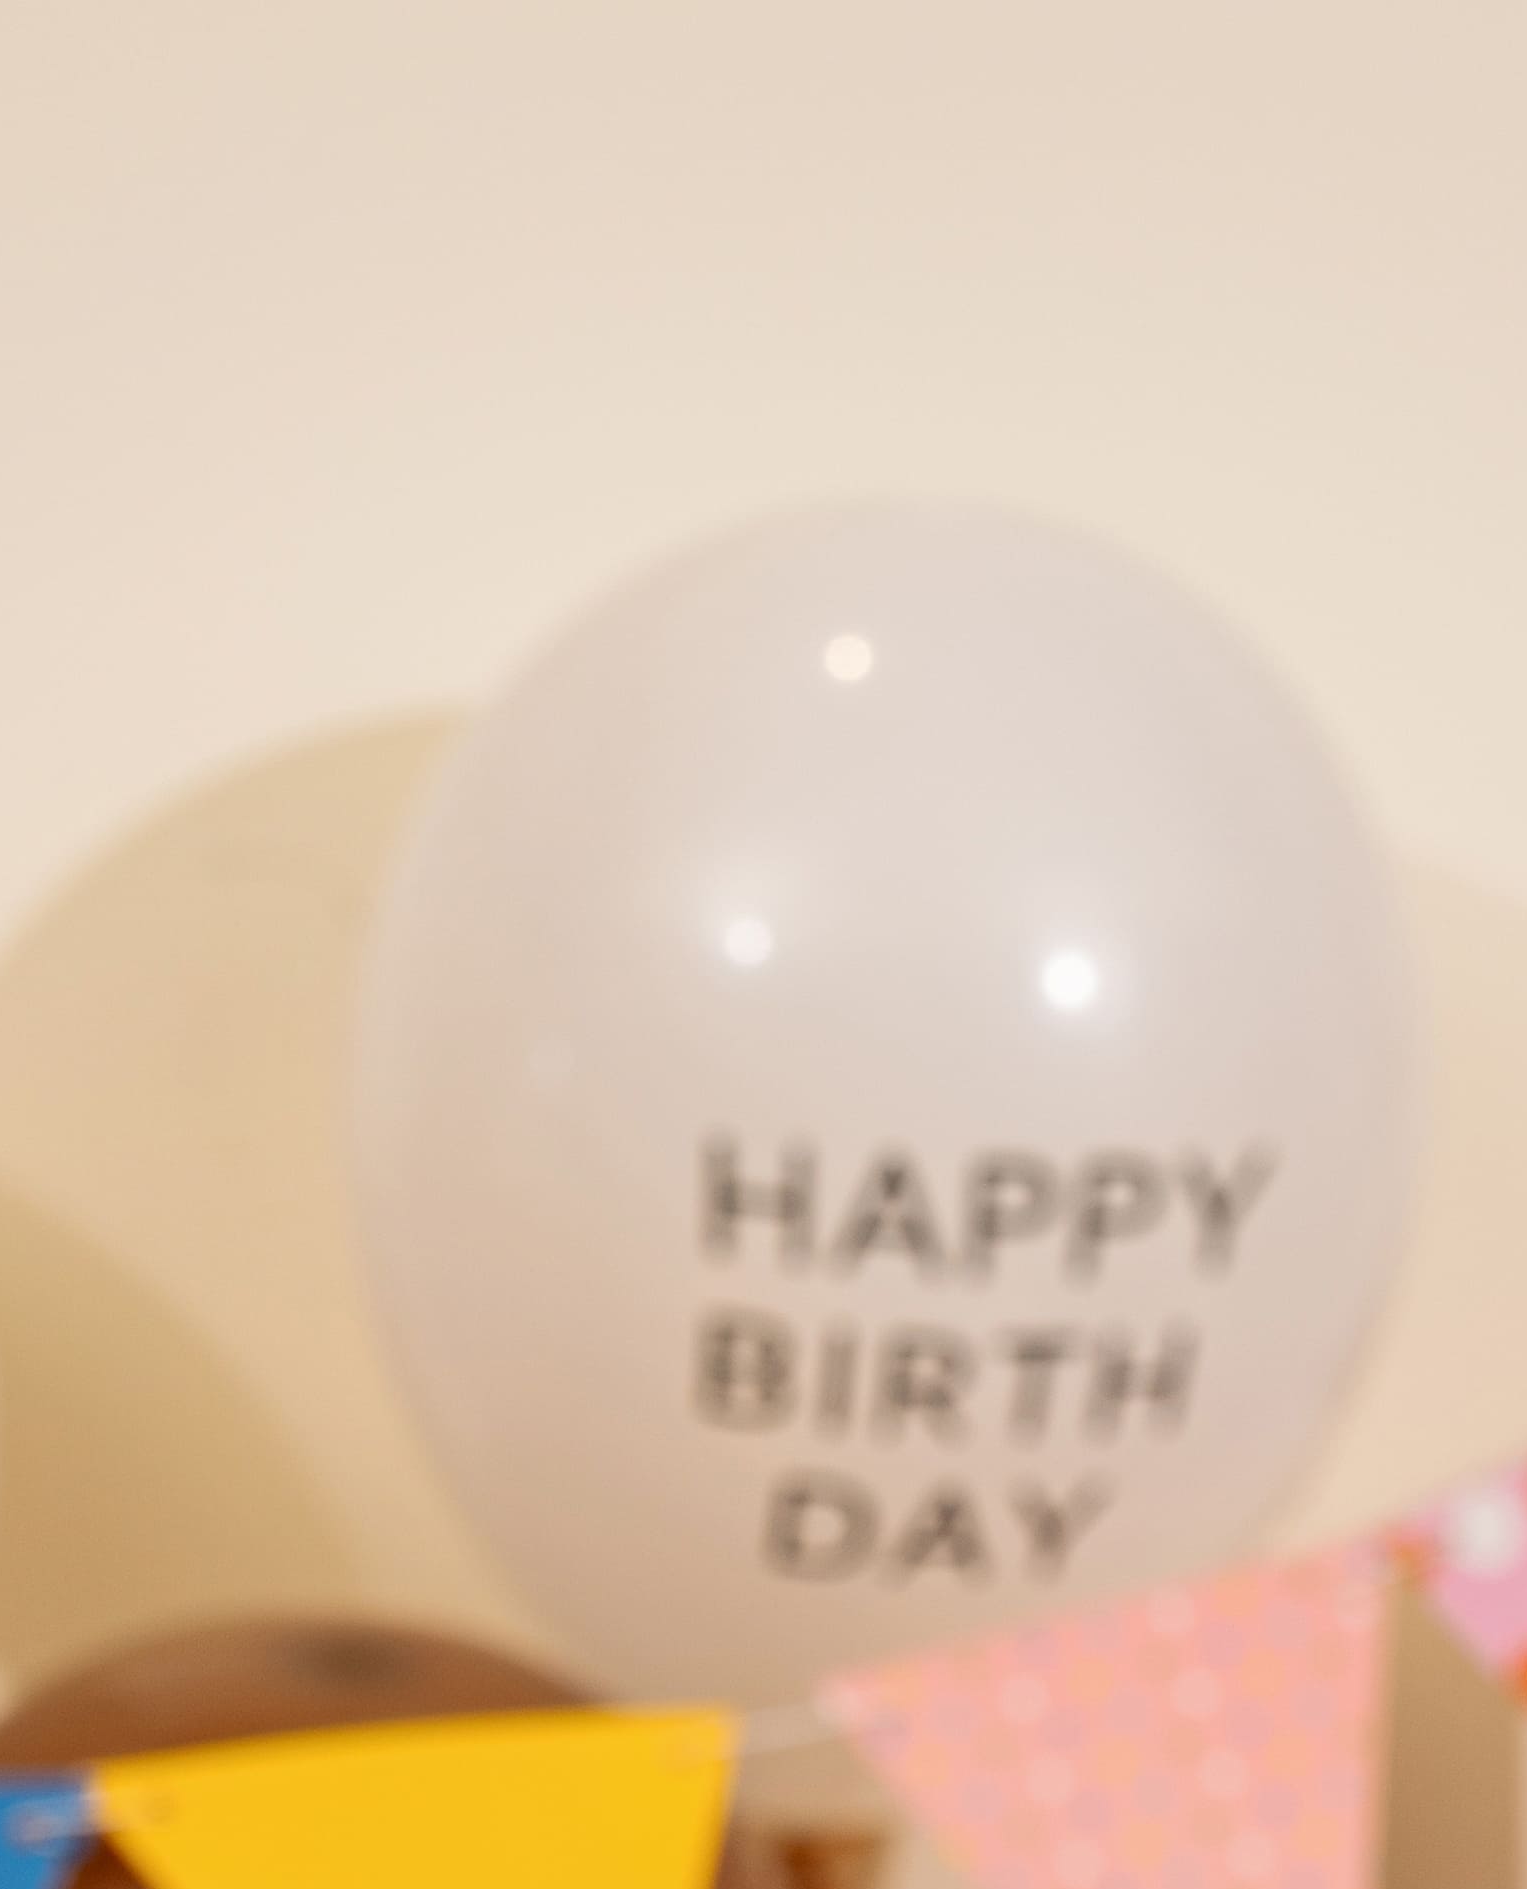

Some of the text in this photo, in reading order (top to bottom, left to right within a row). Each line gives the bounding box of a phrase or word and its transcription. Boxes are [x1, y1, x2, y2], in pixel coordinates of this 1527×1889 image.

[696, 1133, 1278, 1285] HAPPY
[690, 1308, 1200, 1444] BIRTH
[760, 1469, 1114, 1586] DAY
